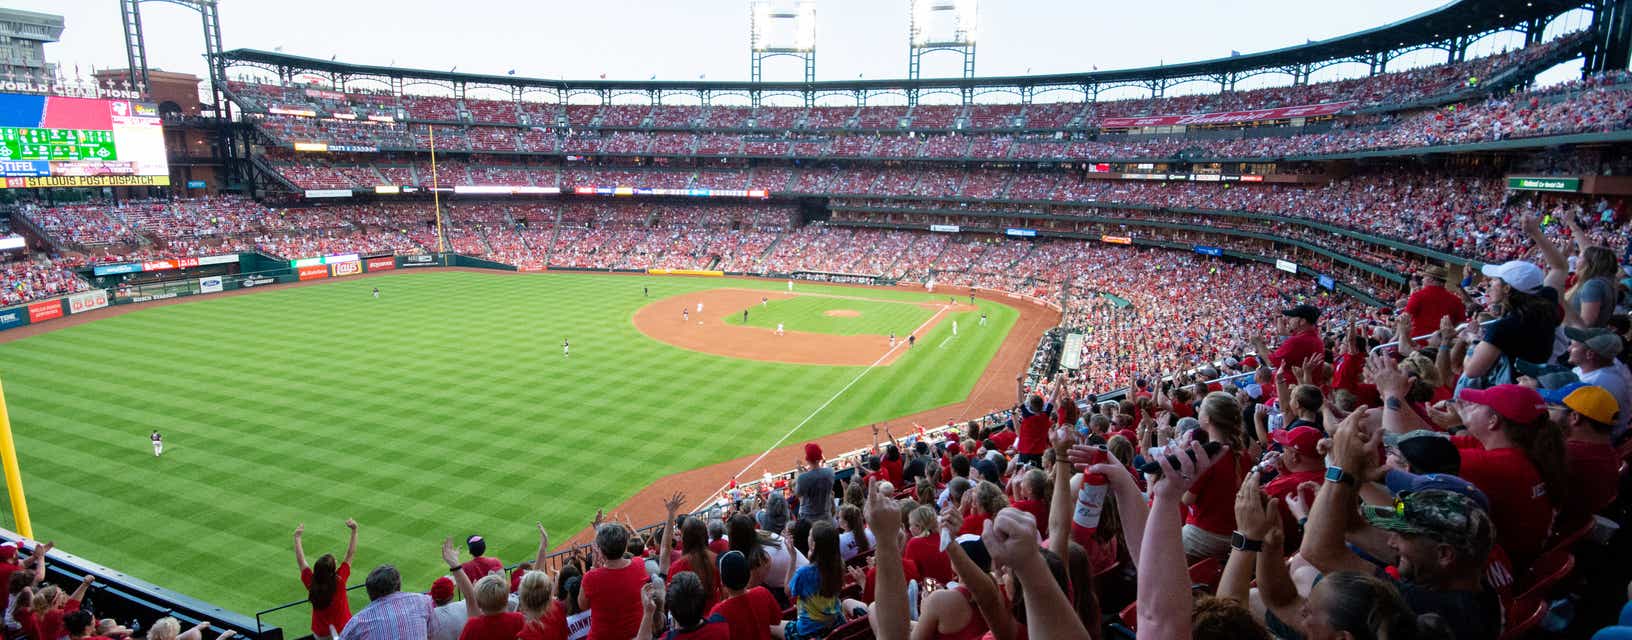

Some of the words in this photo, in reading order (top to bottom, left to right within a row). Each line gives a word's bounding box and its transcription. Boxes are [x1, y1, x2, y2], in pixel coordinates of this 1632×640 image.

[52, 84, 140, 98] CHAMPIONS
[0, 161, 37, 171] STIFEL
[46, 176, 76, 186] LOUIS
